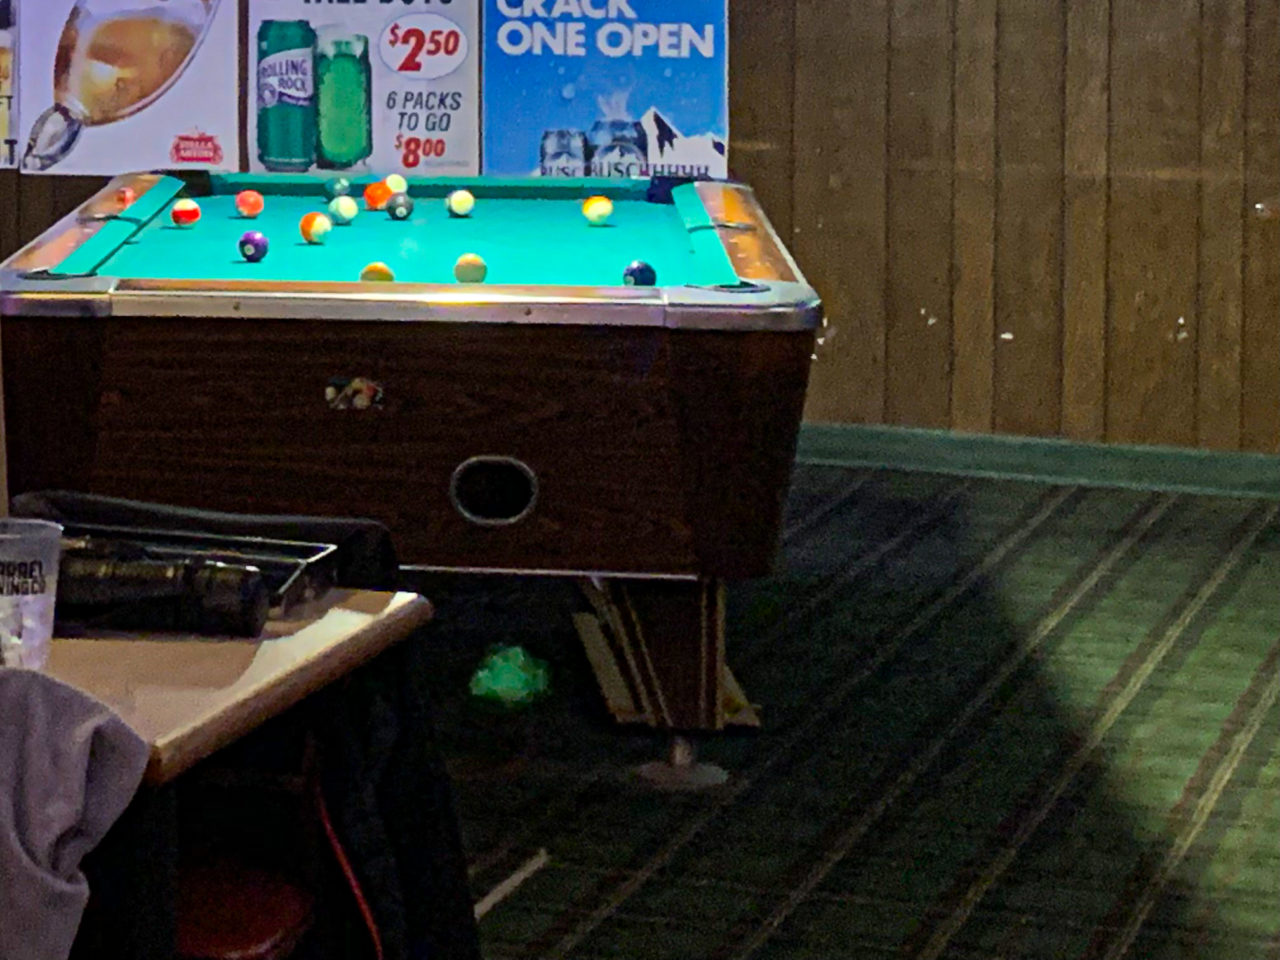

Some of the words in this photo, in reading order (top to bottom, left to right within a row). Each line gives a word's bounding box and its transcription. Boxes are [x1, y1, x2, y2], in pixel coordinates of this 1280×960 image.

[496, 20, 587, 57] ONE
[596, 21, 715, 59] OPEN
[385, 92, 397, 110] 6
[401, 92, 462, 111] PACKS
[397, 112, 419, 131] TO
[423, 113, 452, 132] GO
